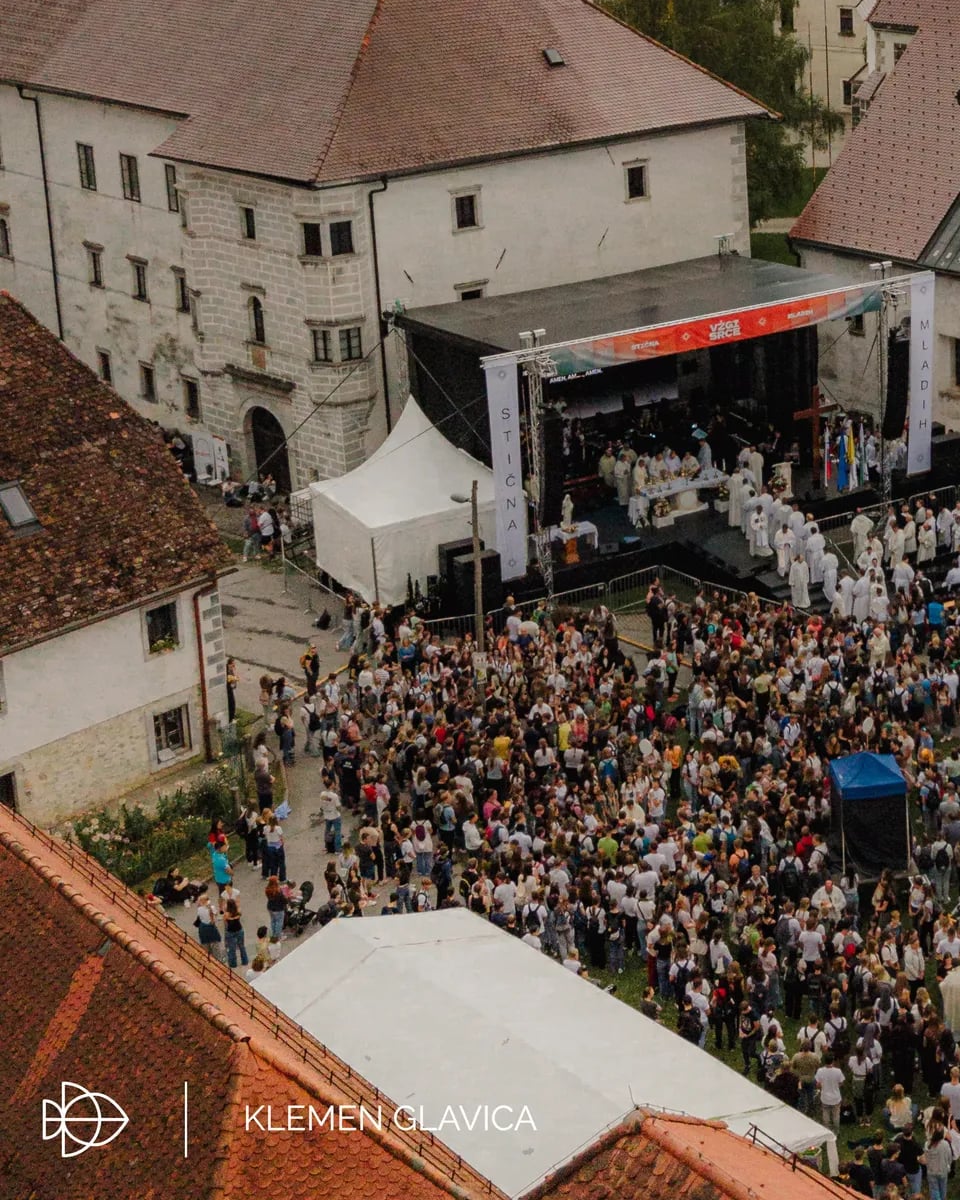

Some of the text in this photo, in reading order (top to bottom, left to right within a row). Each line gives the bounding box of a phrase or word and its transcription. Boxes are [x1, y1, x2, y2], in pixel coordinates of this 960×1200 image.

[710, 328, 741, 340] SRCE
[919, 320, 930, 428] MLADIH
[501, 408, 518, 530] STIČNA
